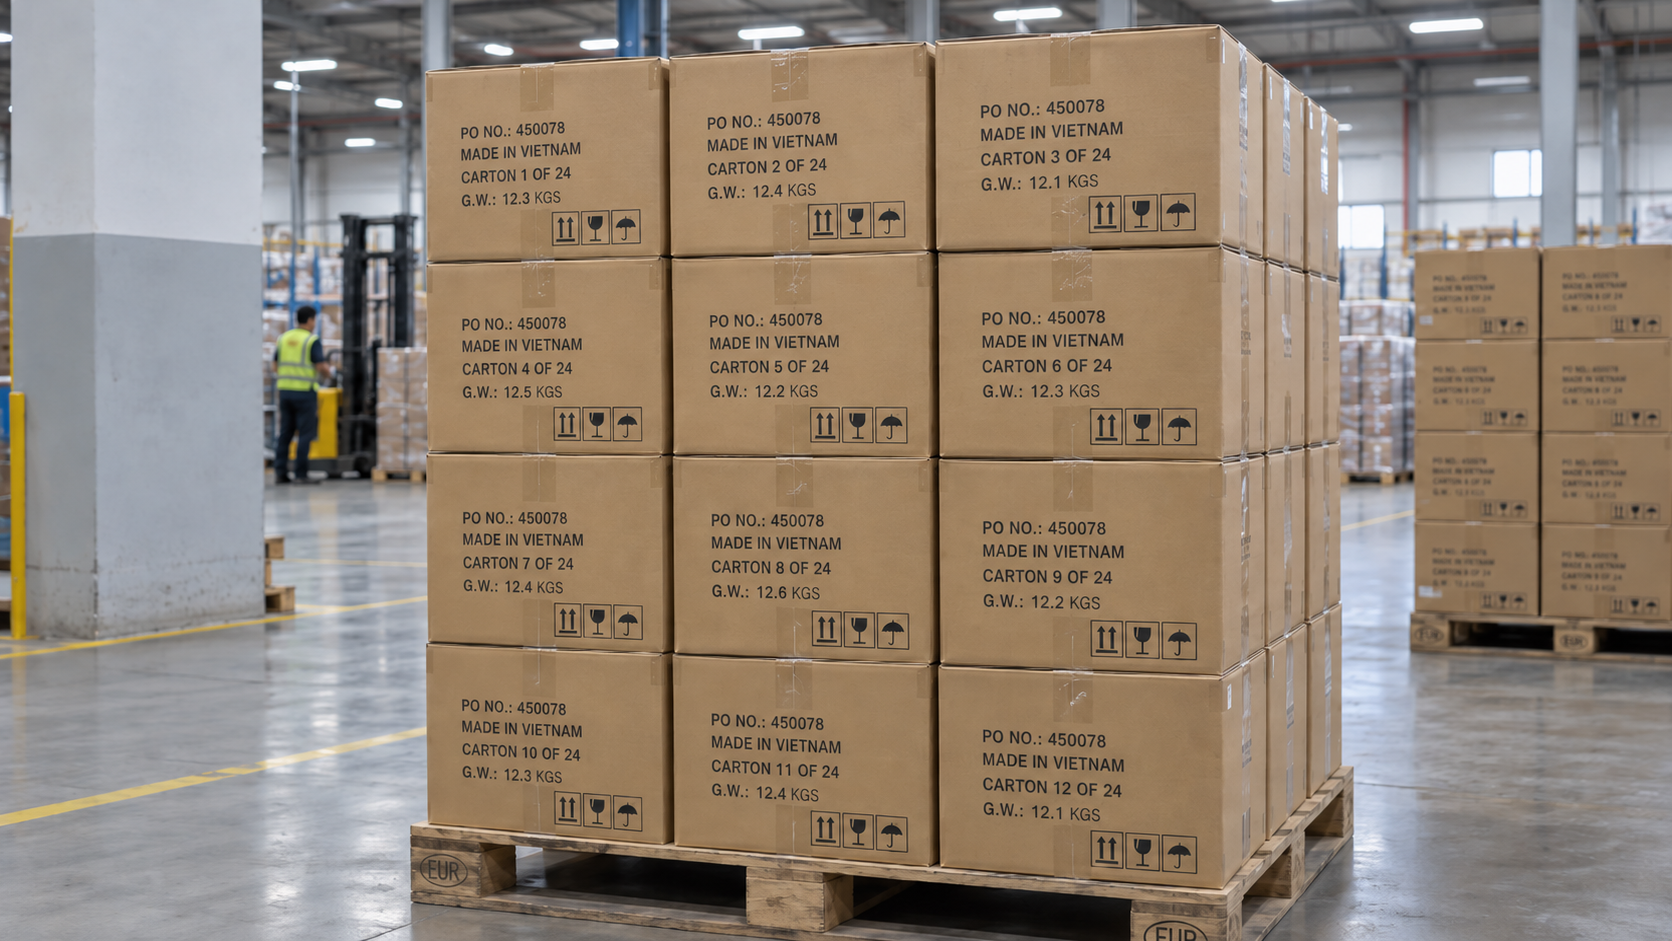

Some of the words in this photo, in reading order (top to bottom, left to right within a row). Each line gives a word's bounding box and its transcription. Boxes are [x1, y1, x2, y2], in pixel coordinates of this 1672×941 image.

[980, 104, 1002, 119] PO
[1007, 102, 1040, 118] NO.:
[1046, 98, 1105, 115] 450078
[707, 116, 727, 130] PO
[732, 114, 762, 129] NO.:
[767, 111, 821, 127] 450078
[460, 126, 479, 140] PO
[483, 124, 511, 138] NO.:
[515, 121, 566, 137] 450078
[980, 126, 1026, 142] MADE
[1030, 125, 1046, 140] IN
[1051, 121, 1123, 138] VIETNAM
[707, 137, 749, 153] MADE
[753, 136, 768, 150] IN
[771, 132, 838, 149] VIETNAM
[460, 146, 499, 162] MADE
[503, 145, 516, 159] IN
[520, 141, 581, 158] VIETNAM
[980, 150, 1046, 167] CARTON
[1050, 149, 1060, 164] 3
[1065, 148, 1087, 163] OF
[1092, 147, 1112, 162] 24
[461, 169, 516, 184] CARTON
[521, 168, 527, 182] 1
[532, 167, 551, 181] OF
[555, 166, 572, 180] 24
[707, 160, 767, 176] CARTON
[772, 159, 781, 173] 2
[785, 158, 805, 173] OF
[809, 157, 827, 172] 24
[707, 185, 745, 200] G.W.:
[753, 184, 783, 198] 12.4
[788, 182, 817, 197] KGS
[981, 176, 1021, 192] G.W.:
[1029, 175, 1060, 190] 12.1
[1068, 173, 1099, 188] KGS
[461, 193, 496, 207] G.W.:
[502, 191, 530, 206] 12.3
[534, 190, 561, 204] KGS
[461, 317, 481, 332] PO
[484, 317, 513, 331] NO.:
[517, 316, 567, 330] 450078
[709, 314, 729, 328] PO
[734, 313, 764, 328] NO.:
[769, 312, 823, 327] 450078
[982, 311, 1003, 326] PO
[1008, 311, 1041, 325] NO.:
[1047, 309, 1106, 325] 450078
[462, 339, 501, 353] MADE
[504, 338, 518, 352] IN
[521, 337, 583, 352] VIETNAM
[709, 336, 751, 350] MADE
[755, 336, 770, 349] IN
[774, 334, 840, 349] VIETNAM
[982, 334, 1027, 349] MADE
[1032, 334, 1047, 348] IN
[1052, 332, 1124, 348] VIETNAM
[462, 362, 518, 376] CARTON
[521, 362, 530, 375] 4
[534, 361, 552, 375] OF
[556, 361, 573, 375] 24
[709, 360, 770, 374] CARTON
[774, 360, 783, 374] 5
[787, 359, 807, 373] OF
[811, 359, 830, 373] 24
[982, 359, 1047, 374] CARTON
[1052, 359, 1062, 373] 6
[1067, 358, 1088, 373] OF
[1093, 358, 1113, 373] 24
[462, 385, 498, 399] G.W.:
[504, 385, 532, 399] 12.5
[536, 385, 563, 399] KGS
[710, 384, 747, 398] G.W.:
[755, 384, 785, 398] 12.2
[790, 384, 819, 398] KGS
[982, 384, 1023, 398] G.W.:
[1031, 384, 1064, 398] 12.3
[1069, 383, 1100, 398] KGS
[462, 511, 482, 525] PO
[485, 511, 514, 525] NO.:
[518, 511, 568, 525] 450078
[711, 513, 731, 527] PO
[735, 513, 766, 527] NO.:
[770, 513, 825, 528] 450078
[982, 520, 1004, 535] PO
[1009, 520, 1042, 535] NO.:
[1047, 521, 1106, 536] 450078
[462, 532, 501, 546] MADE
[505, 533, 519, 546] IN
[522, 533, 584, 547] VIETNAM
[711, 536, 753, 550] MADE
[757, 536, 772, 550] IN
[775, 536, 842, 551] VIETNAM
[983, 543, 1028, 558] MADE
[1033, 544, 1048, 558] IN
[1053, 544, 1124, 559] VIETNAM
[463, 555, 518, 570] CARTON
[522, 557, 531, 570] 7
[534, 556, 553, 571] OF
[557, 557, 574, 571] 24
[711, 559, 771, 575] CARTON
[775, 561, 785, 575] 8
[789, 561, 809, 575] OF
[813, 561, 832, 575] 24
[983, 568, 1048, 584] CARTON
[1052, 569, 1062, 584] 9
[1067, 569, 1089, 584] OF
[1093, 570, 1113, 585] 24
[463, 579, 498, 593] G.W.:
[505, 580, 533, 593] 12.4
[537, 581, 564, 595] KGS
[711, 584, 749, 598] G.W.:
[757, 585, 787, 600] 12.6
[792, 586, 821, 600] KGS
[983, 593, 1024, 608] G.W.:
[1031, 595, 1064, 609] 12.2
[1070, 595, 1101, 610] KGS
[461, 698, 480, 712] PO
[484, 699, 512, 714] NO.:
[517, 701, 567, 716] 450078
[461, 720, 501, 735] MADE
[504, 722, 518, 735] IN
[521, 722, 583, 738] VIETNAM
[711, 713, 731, 727] PO
[735, 714, 766, 729] NO.:
[770, 715, 824, 731] 450078
[711, 735, 753, 750] MADE
[757, 737, 771, 751] IN
[775, 737, 841, 754] VIETNAM
[982, 729, 1004, 744] PO
[1009, 730, 1042, 746] NO.:
[1047, 732, 1107, 749] 450078
[462, 742, 517, 758] CARTON
[522, 746, 538, 760] 10
[541, 746, 560, 761] OF
[564, 748, 581, 762] 24
[711, 759, 771, 775] CARTON
[776, 762, 791, 777] 11
[797, 763, 818, 778] OF
[822, 764, 840, 779] 24
[982, 752, 1028, 768] MADE
[1032, 754, 1048, 769] IN
[1053, 755, 1125, 773] VIETNAM
[462, 765, 497, 780] G.W.:
[504, 768, 532, 783] 12.3
[536, 770, 563, 784] KGS
[711, 783, 749, 798] G.W.:
[756, 785, 787, 800] 12.4
[791, 787, 819, 802] KGS
[982, 777, 1048, 794] CARTON
[1053, 781, 1072, 796] 12
[1076, 782, 1098, 797] OF
[1103, 783, 1122, 798] 24
[983, 801, 1024, 818] G.W.:
[1031, 804, 1062, 820] 12.1
[1070, 807, 1101, 822] KGS
[428, 859, 460, 881] EUR
